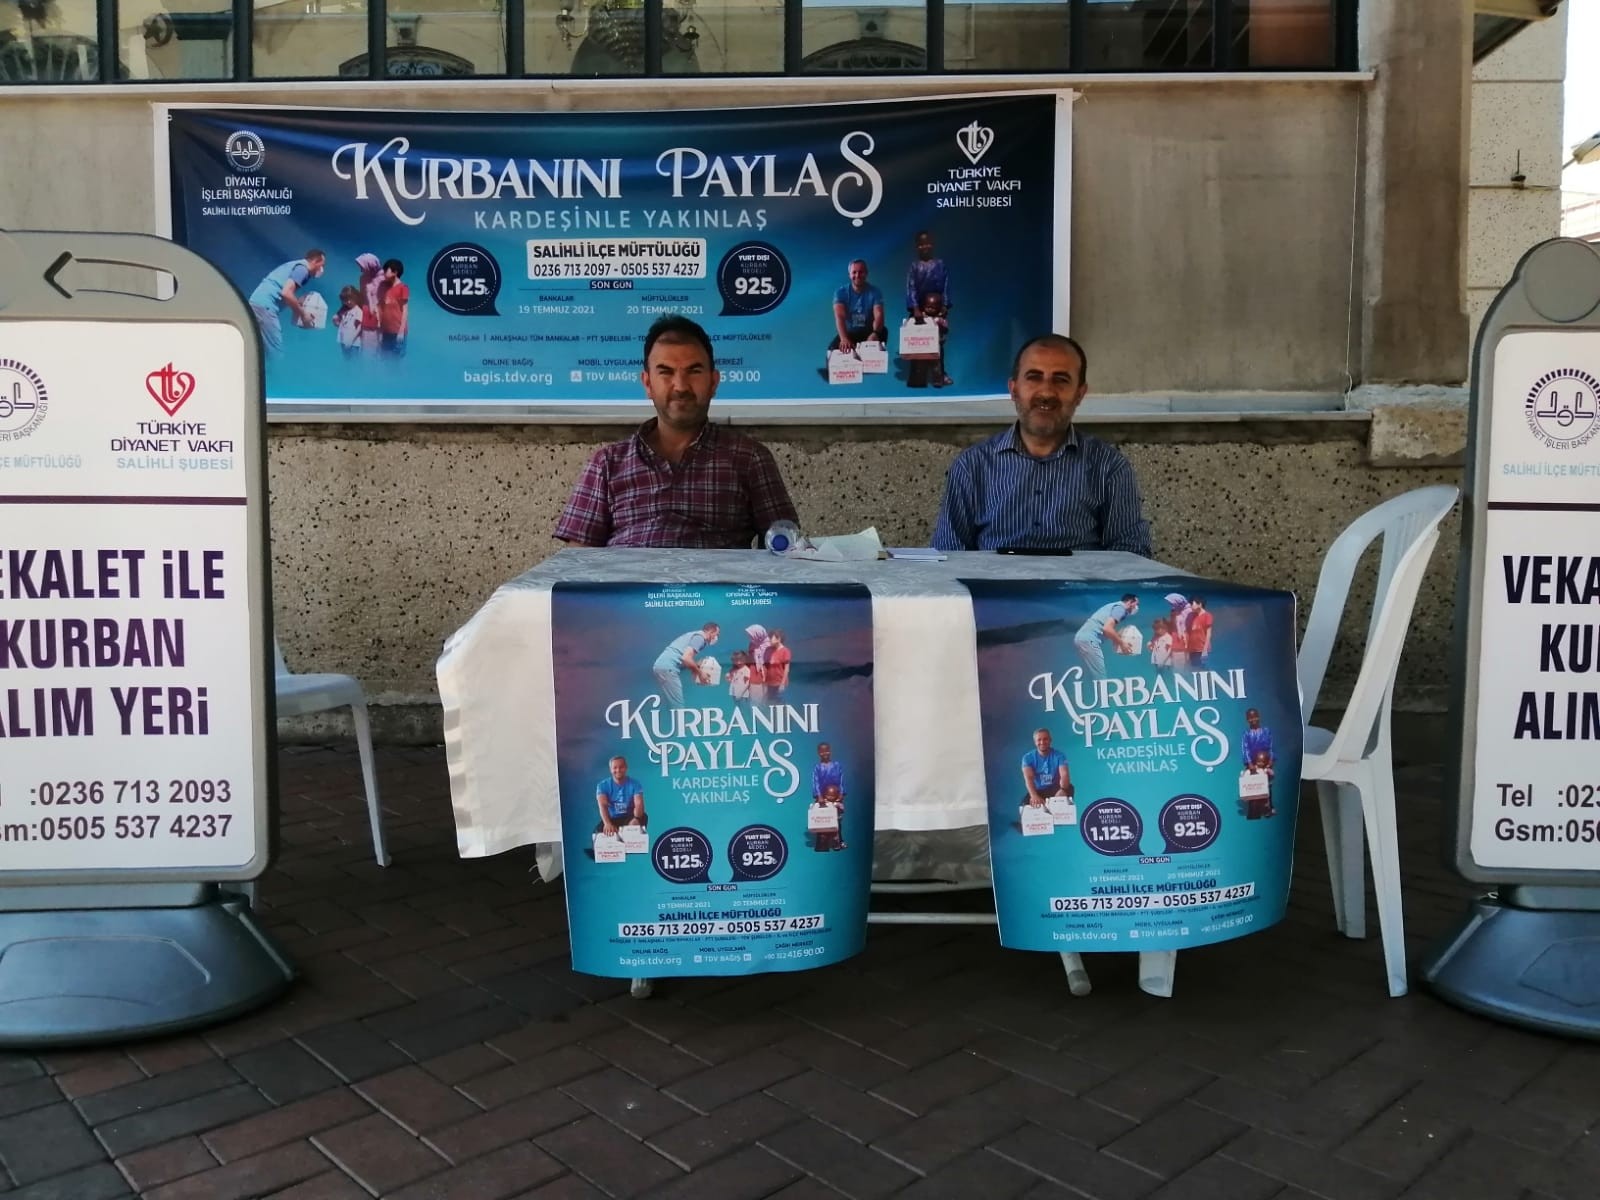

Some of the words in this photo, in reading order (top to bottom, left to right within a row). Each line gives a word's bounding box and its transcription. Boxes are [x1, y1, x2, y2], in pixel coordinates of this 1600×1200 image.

[225, 174, 266, 186] DİYANET
[332, 137, 623, 226] KURBANINI
[655, 131, 883, 227] PAYLAŞ
[948, 166, 1001, 179] TÜRKİYE
[928, 181, 980, 193] DİYANET
[986, 180, 1020, 190] VAKFI
[202, 187, 231, 202] İŞLERİ
[234, 187, 292, 201] BAŞKANLIĞI
[937, 195, 974, 208] SALİHLİ
[976, 195, 1011, 208] ŞUBESİ
[474, 206, 630, 232] KARDEŞİNLE
[643, 209, 767, 231] YAKINLAŞ
[534, 242, 585, 259] SALİHLİ
[587, 242, 615, 259] İLÇE
[618, 241, 700, 257] MÜFTÜLÜĞÜ
[534, 263, 561, 277] 0236
[564, 263, 581, 276] 713
[584, 263, 611, 276] 2097
[621, 263, 649, 276] 0505
[652, 263, 670, 276] 537
[673, 263, 700, 276] 4237
[591, 281, 610, 289] SON
[533, 306, 571, 314] TEMMUZ
[572, 306, 595, 314] 2021
[627, 306, 638, 314] 20
[642, 305, 679, 314] TEMMUZ
[682, 305, 703, 313] 2021
[464, 371, 553, 385] bagis.tdv.org
[586, 372, 605, 381] TDV
[729, 370, 743, 382] 90
[746, 370, 760, 382] 00
[136, 419, 206, 436] TÜRKİYE
[111, 436, 180, 452] DİYANET
[187, 440, 233, 452] VAKFI
[14, 454, 82, 468] MÜFTÜLÜĞÜ
[117, 456, 174, 469] SALİHLİ
[179, 457, 233, 471] ŞUBESİ
[1503, 461, 1542, 476] SALİHLİ
[1544, 462, 1566, 477] İLÇE
[0, 550, 145, 599] KALET
[0, 618, 185, 669] KURBAN
[1540, 624, 1600, 673] KU
[1028, 666, 1247, 725] KURBANINI
[606, 695, 820, 754] KURBANINI
[1072, 706, 1229, 772] PAYLAŞ
[1097, 742, 1186, 760] KARDEŞİNLE
[648, 739, 800, 803] PAYLAŞ
[1107, 759, 1178, 774] YAKINLAŞ
[672, 773, 759, 790] KARDEŞİNLE
[114, 780, 160, 803] 713
[169, 780, 232, 803] 2093
[682, 790, 750, 804] YAKINLAŞ
[1496, 783, 1532, 806] Tel
[115, 816, 161, 839] 537
[170, 814, 232, 838] 4237
[1091, 884, 1129, 895] SALİHLİ
[1132, 884, 1154, 894] İLÇE
[1055, 899, 1088, 910] 0236
[1092, 897, 1113, 909] 713
[1117, 896, 1150, 908] 2097
[1163, 894, 1196, 907] 0505
[1200, 890, 1221, 903] 537
[1225, 885, 1251, 899] 4237
[658, 910, 697, 921] SALİHLİ
[698, 910, 720, 920] İLÇE
[721, 908, 782, 919] MÜFTÜLÜĞÜ
[623, 925, 655, 936] 0236
[659, 924, 679, 935] 713
[683, 922, 715, 934] 2097
[728, 921, 760, 933] 0505
[764, 920, 786, 932] 537
[790, 917, 820, 929] 4237
[804, 948, 813, 956] 90
[620, 957, 682, 966] bagis.tdv.org
